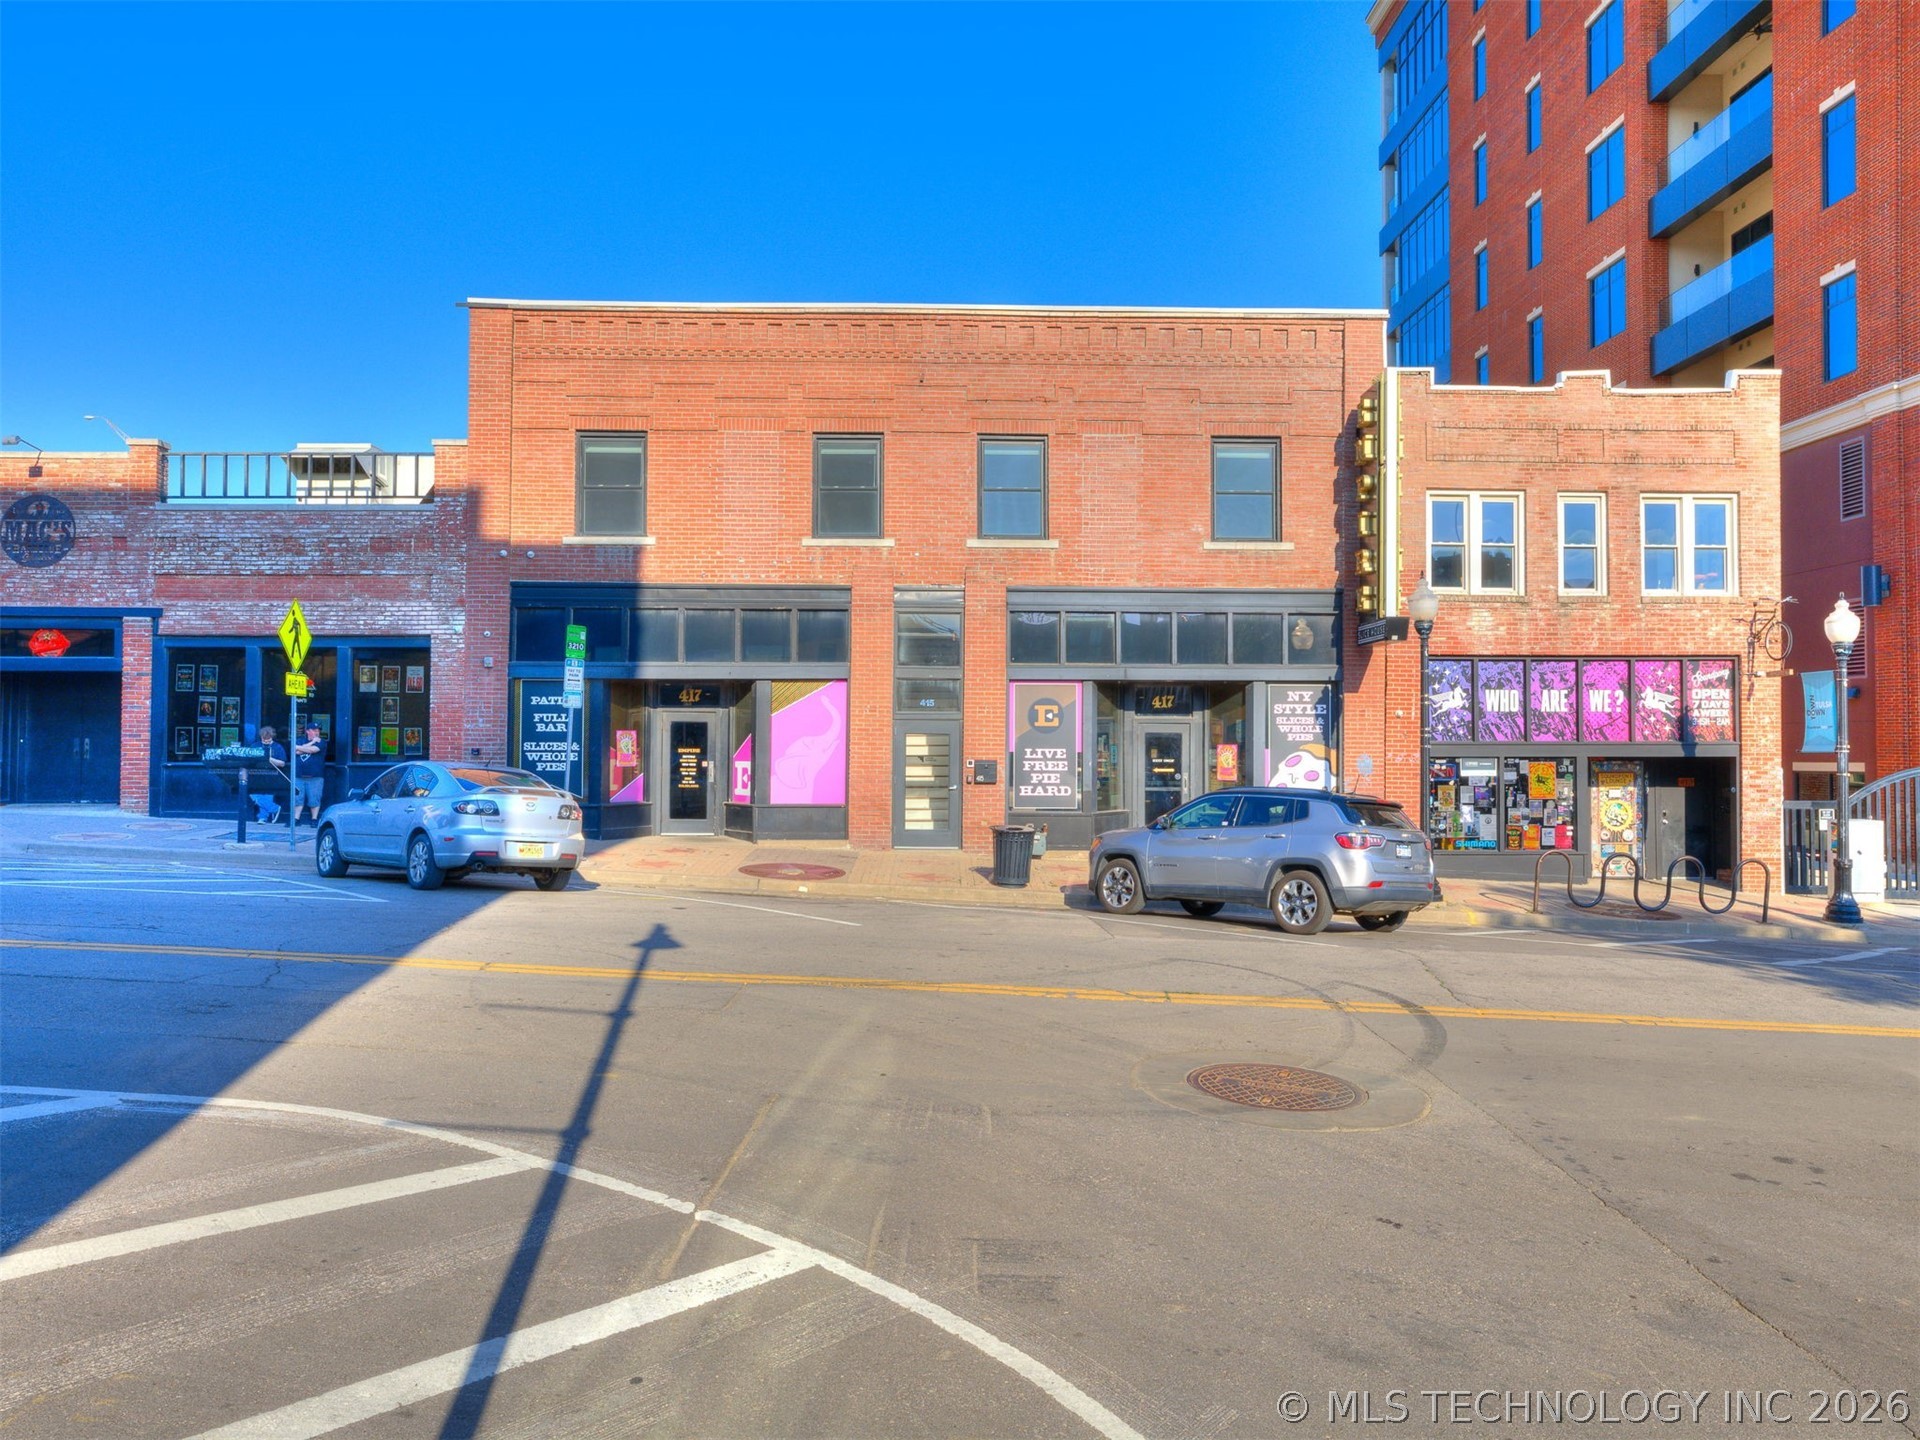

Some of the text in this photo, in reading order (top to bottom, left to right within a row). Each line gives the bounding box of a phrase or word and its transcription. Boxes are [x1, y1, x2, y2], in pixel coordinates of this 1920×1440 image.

[568, 642, 584, 650] 3210
[288, 679, 305, 690] AHEAD
[679, 689, 702, 702] 417
[1287, 691, 1314, 702] NY
[1691, 688, 1730, 700] OPEN
[530, 696, 564, 705] PATI
[919, 698, 935, 707] 415
[1152, 695, 1174, 709] 417
[1485, 689, 1519, 713] WHO
[1540, 689, 1568, 713] ARE
[1692, 699, 1730, 709] 7 DAYS
[1273, 703, 1327, 715] STYLE
[1692, 708, 1730, 717] A WEEK
[533, 713, 570, 722] FULL
[1034, 704, 1060, 727] E
[1276, 716, 1325, 725] SLICES &
[535, 723, 568, 732] BAR
[1277, 725, 1323, 733] WHOLE
[1287, 733, 1314, 741] PIES
[523, 741, 580, 751] SLICES &
[1024, 748, 1067, 759] LIVE
[535, 762, 567, 771] PIES
[1022, 761, 1068, 771] FREE
[1030, 773, 1061, 784] PIE
[1019, 785, 1072, 796] HARD
